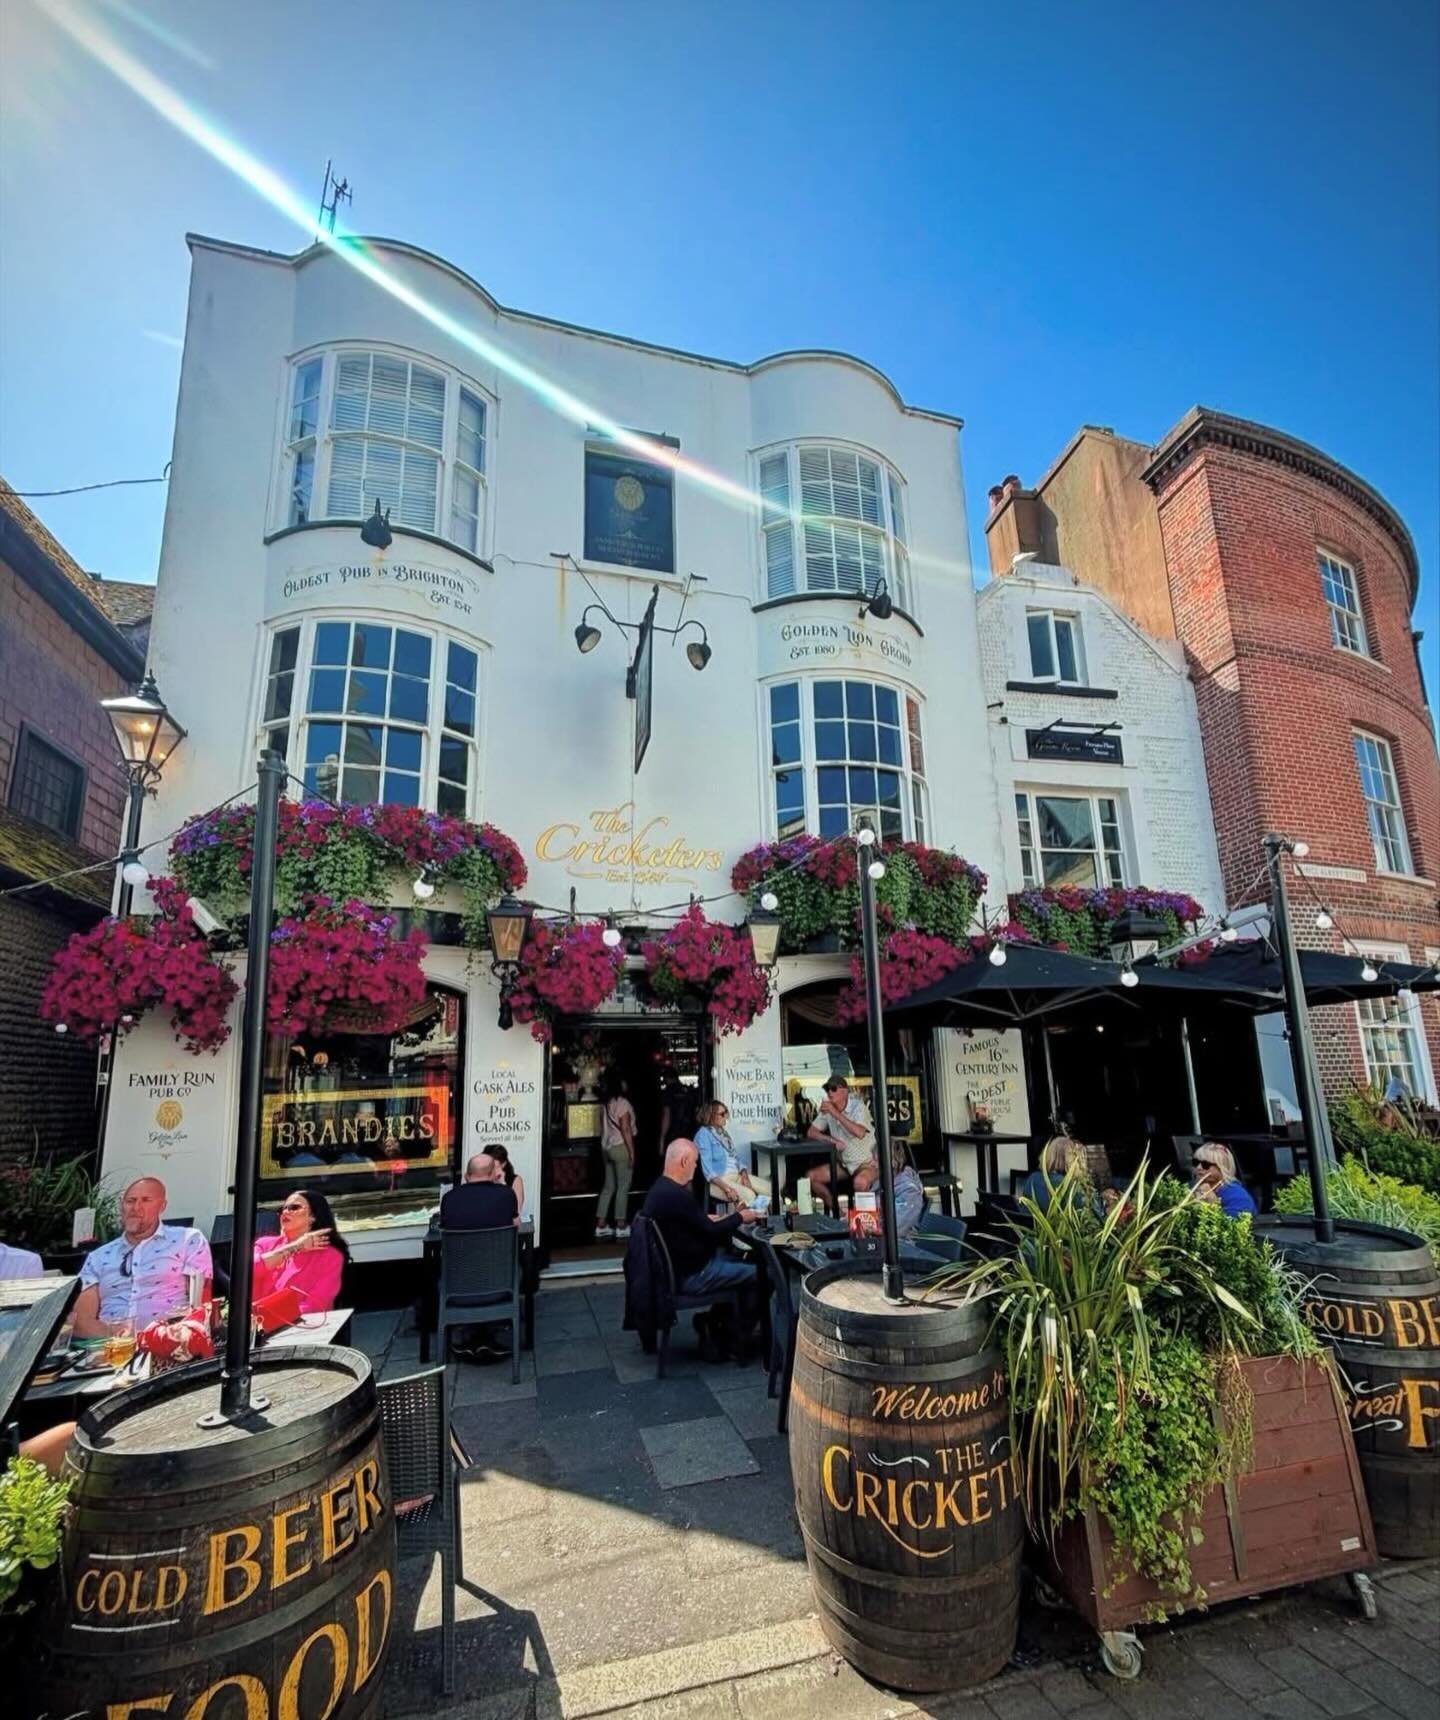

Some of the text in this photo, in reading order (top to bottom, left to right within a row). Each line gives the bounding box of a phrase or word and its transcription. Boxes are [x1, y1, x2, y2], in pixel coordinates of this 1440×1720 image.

[284, 572, 331, 598] OLDEST
[340, 565, 371, 583] PUB
[393, 565, 464, 594] BRIGHTON
[781, 624, 839, 641] GOLDEN
[842, 625, 873, 648] LION
[589, 801, 636, 834] The
[535, 816, 723, 871] Cricketers
[963, 1037, 1000, 1056] FAMOUS
[128, 1071, 215, 1088] FAMILY RUN
[491, 1071, 516, 1080] LOCAL
[726, 1068, 775, 1081] WINE BAR
[955, 1062, 1018, 1077] CENTURY INN
[149, 1087, 173, 1099] PUB
[474, 1080, 535, 1095] CASK ALES
[731, 1091, 773, 1105] PRIVATE
[490, 1105, 516, 1119] PUB
[730, 1107, 755, 1119] ENUE
[276, 1113, 435, 1149] BRANDIES
[475, 1119, 532, 1134] CLASSICS
[1304, 1301, 1385, 1337] COLD
[871, 1384, 989, 1420] Welcome
[1345, 1388, 1408, 1420] reat
[935, 1442, 985, 1475] THE
[822, 1445, 1020, 1558] CRICKET
[76, 1459, 382, 1617] COLD BEER
[106, 1569, 391, 1720] OD
